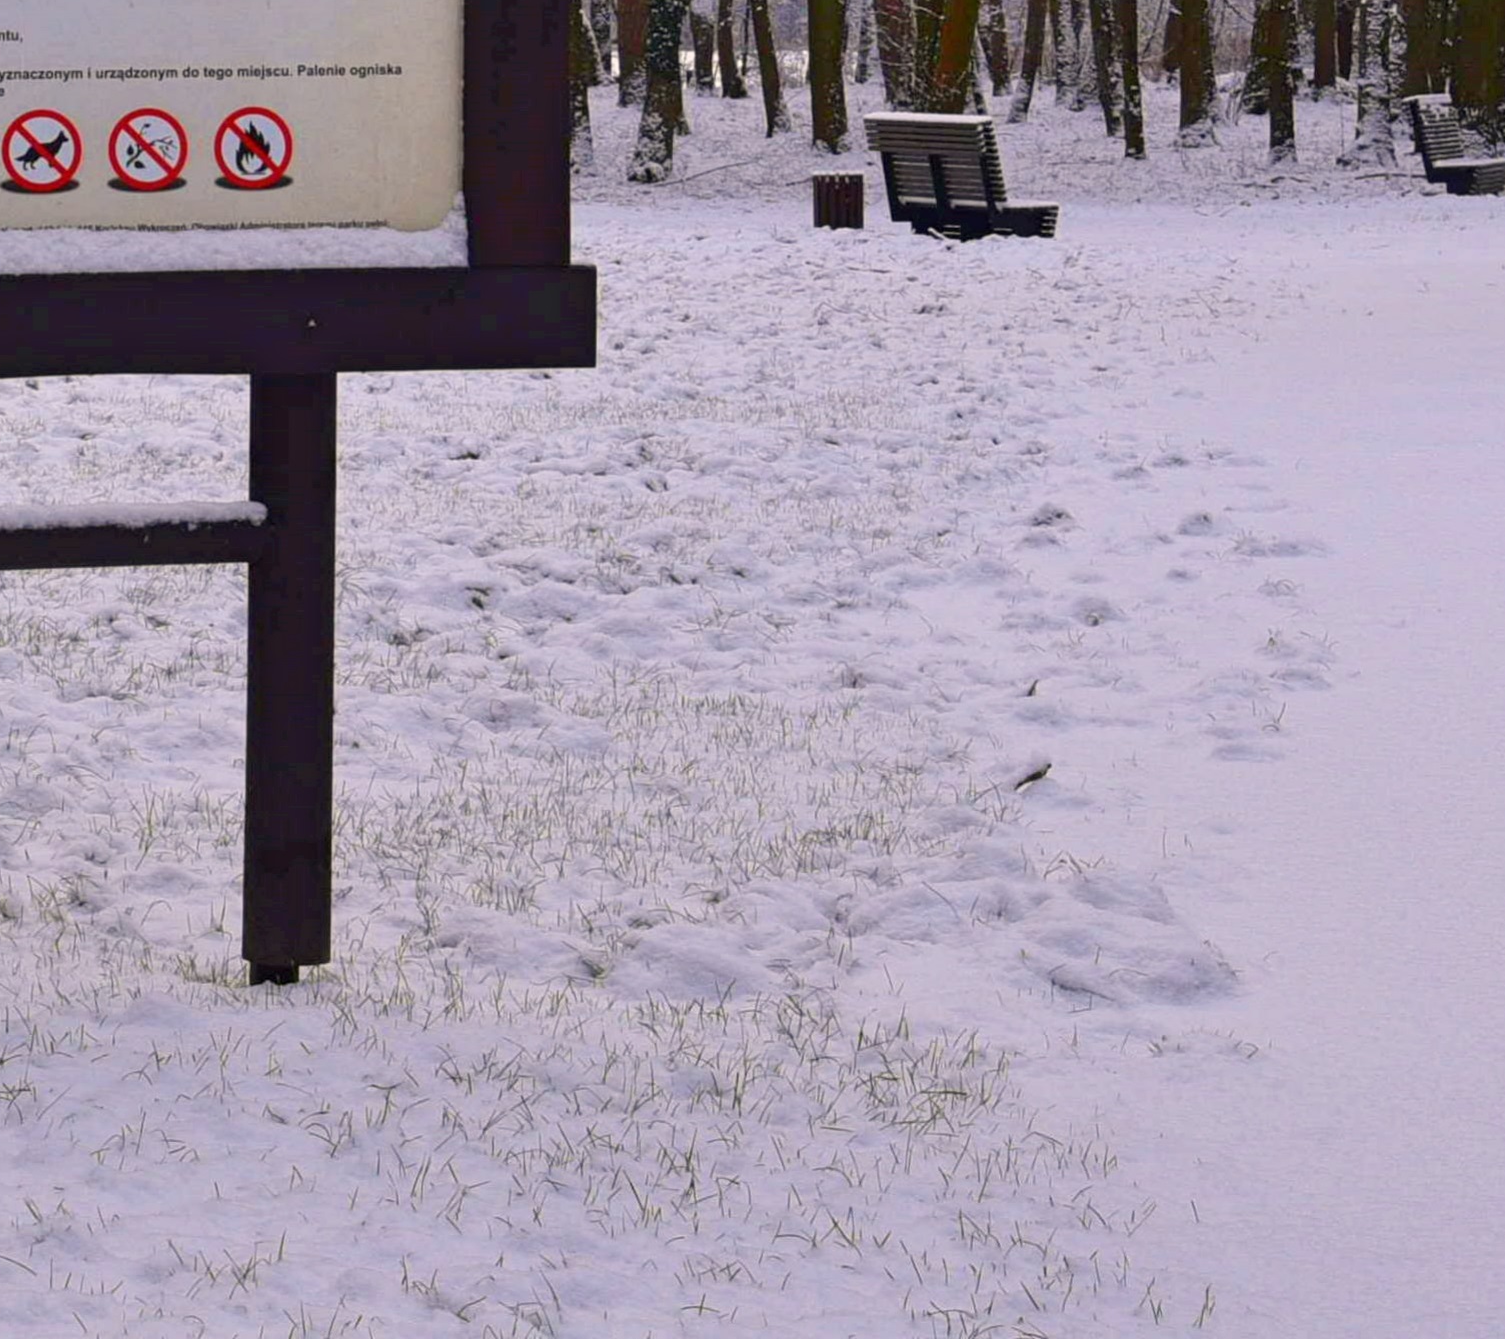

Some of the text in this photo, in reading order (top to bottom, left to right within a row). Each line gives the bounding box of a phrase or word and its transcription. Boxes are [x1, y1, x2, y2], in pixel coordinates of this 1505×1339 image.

[95, 65, 178, 82] urządzonym
[182, 64, 199, 77] do
[203, 64, 233, 81] tego
[237, 64, 293, 81] miejscu.
[297, 63, 346, 76] Palenie
[350, 62, 402, 79] ogniska
